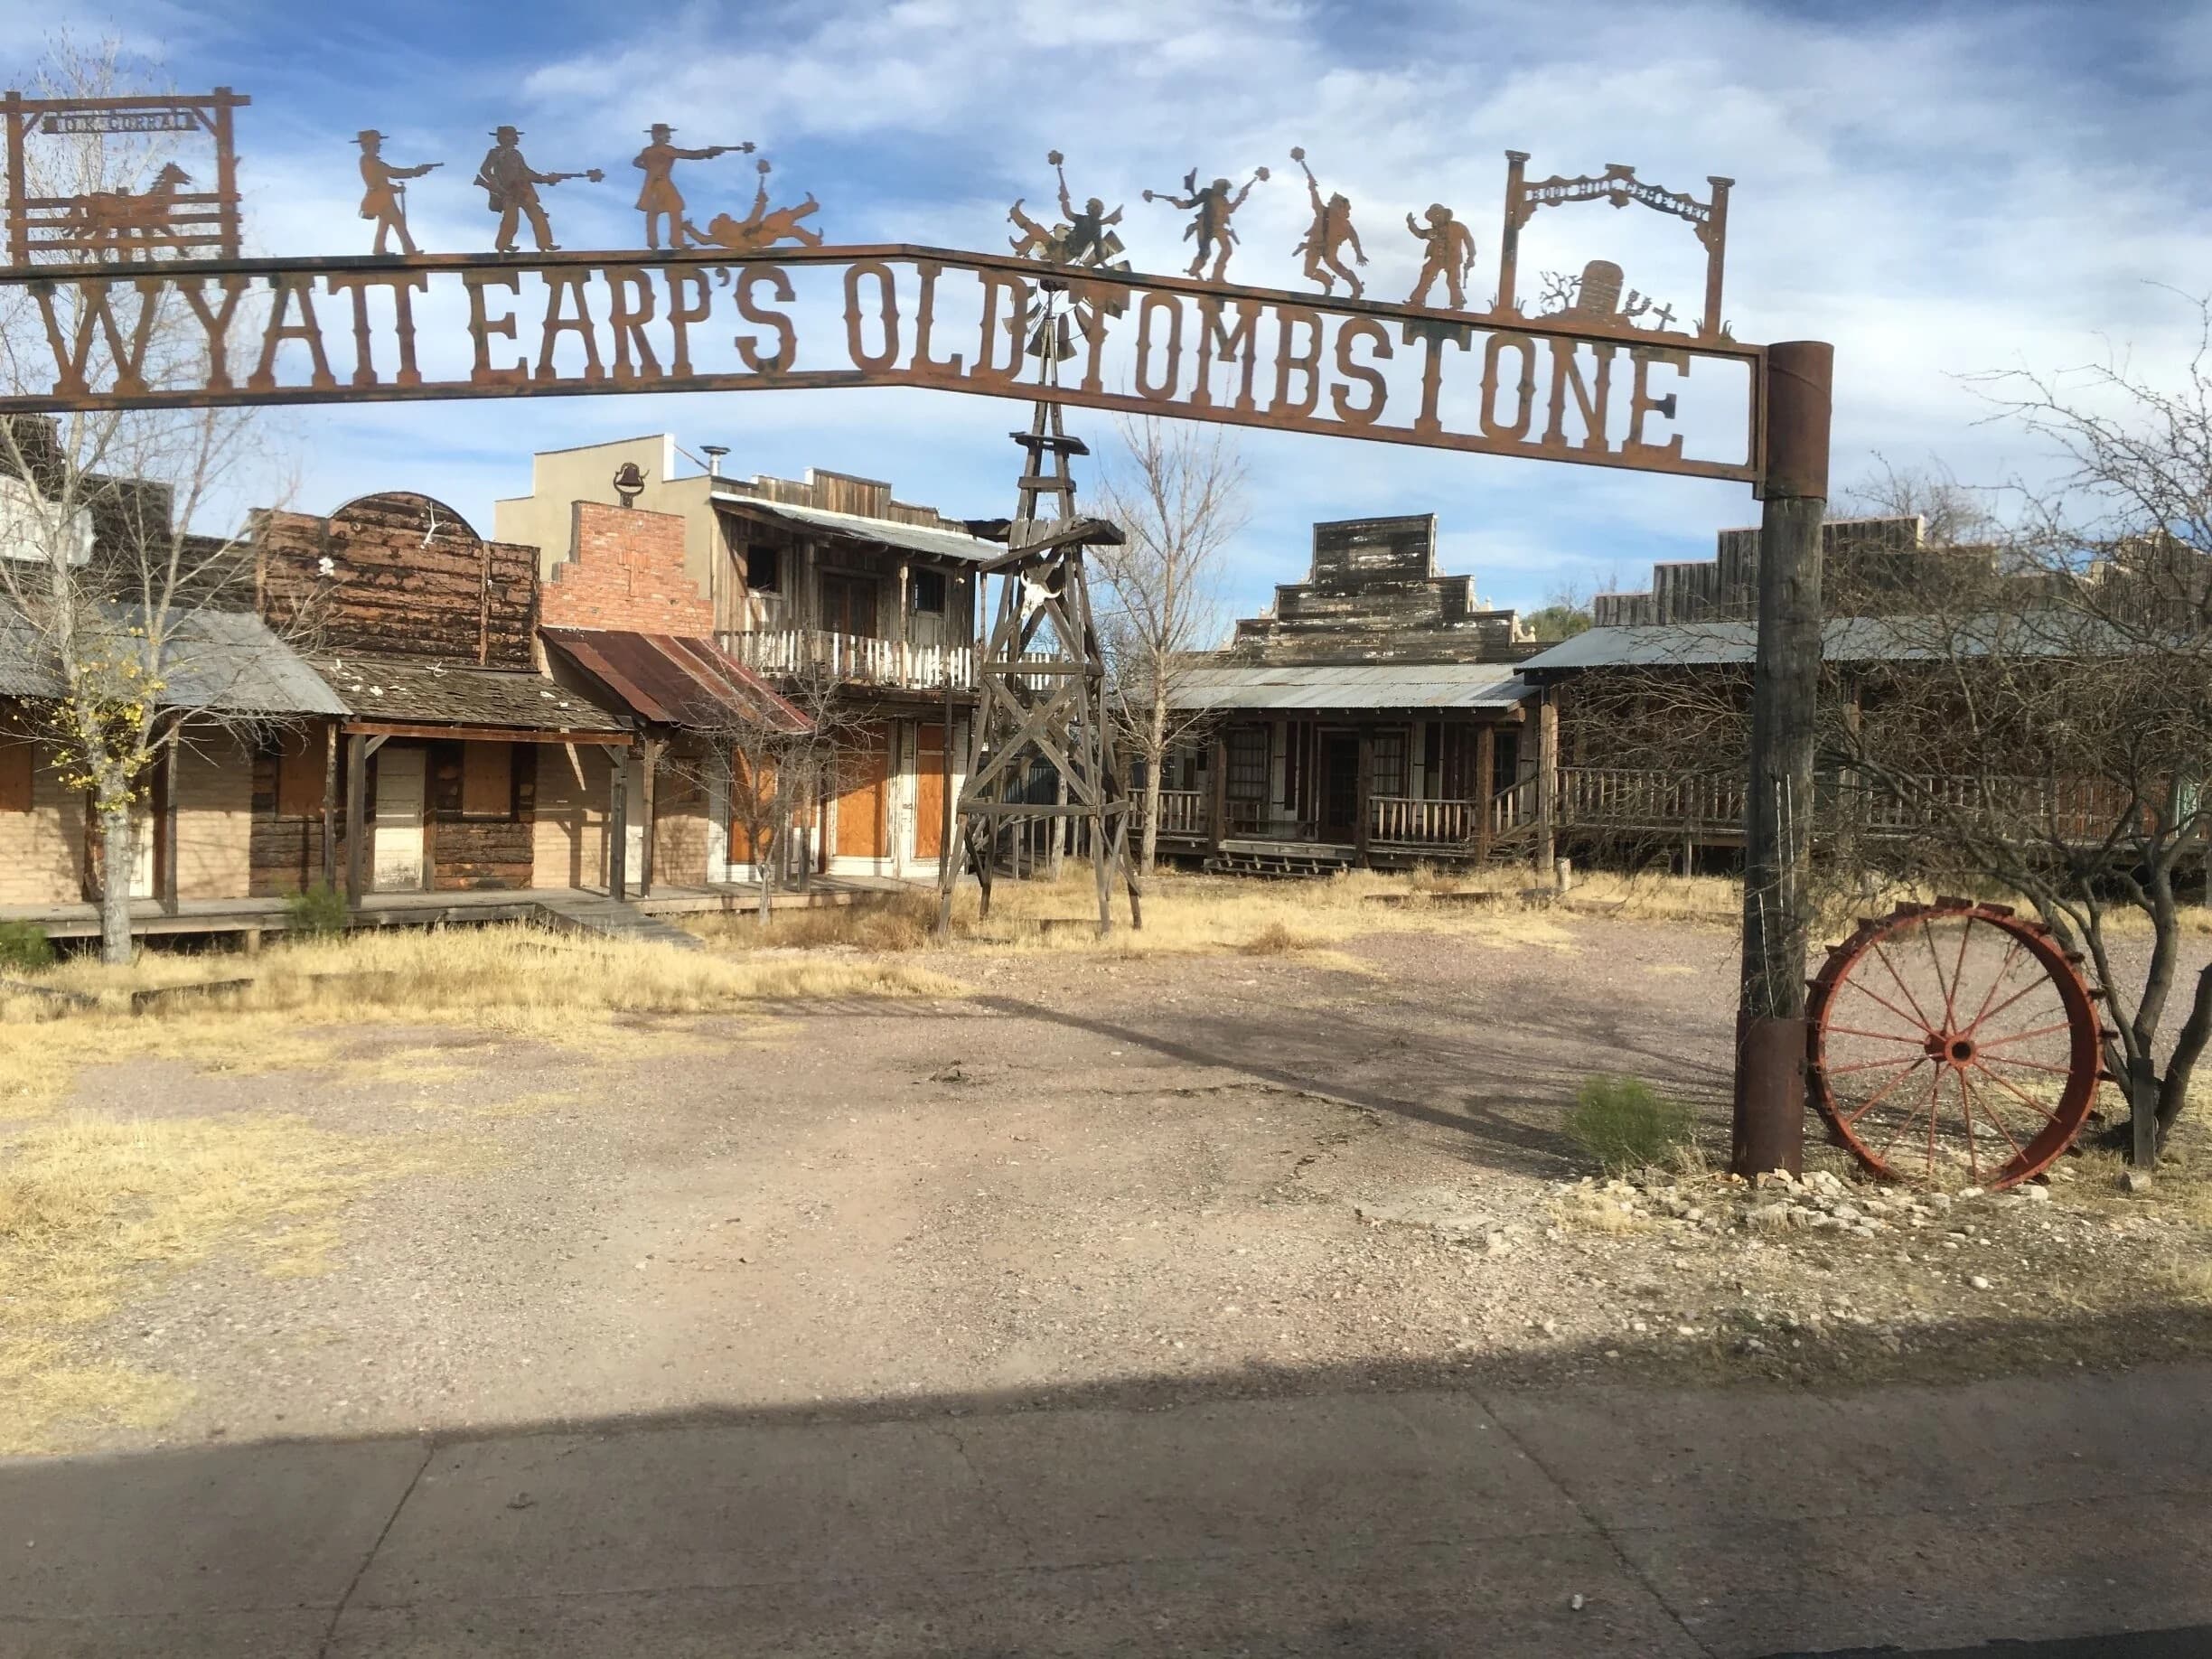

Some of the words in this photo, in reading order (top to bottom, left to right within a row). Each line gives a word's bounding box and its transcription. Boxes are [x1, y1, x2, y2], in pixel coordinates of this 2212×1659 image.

[108, 112, 183, 132] CORRAL
[26, 271, 428, 396] WYATT
[462, 264, 797, 383] EARP'S
[842, 262, 1028, 380] OLD
[1068, 280, 1690, 459] TOMBSTONE
